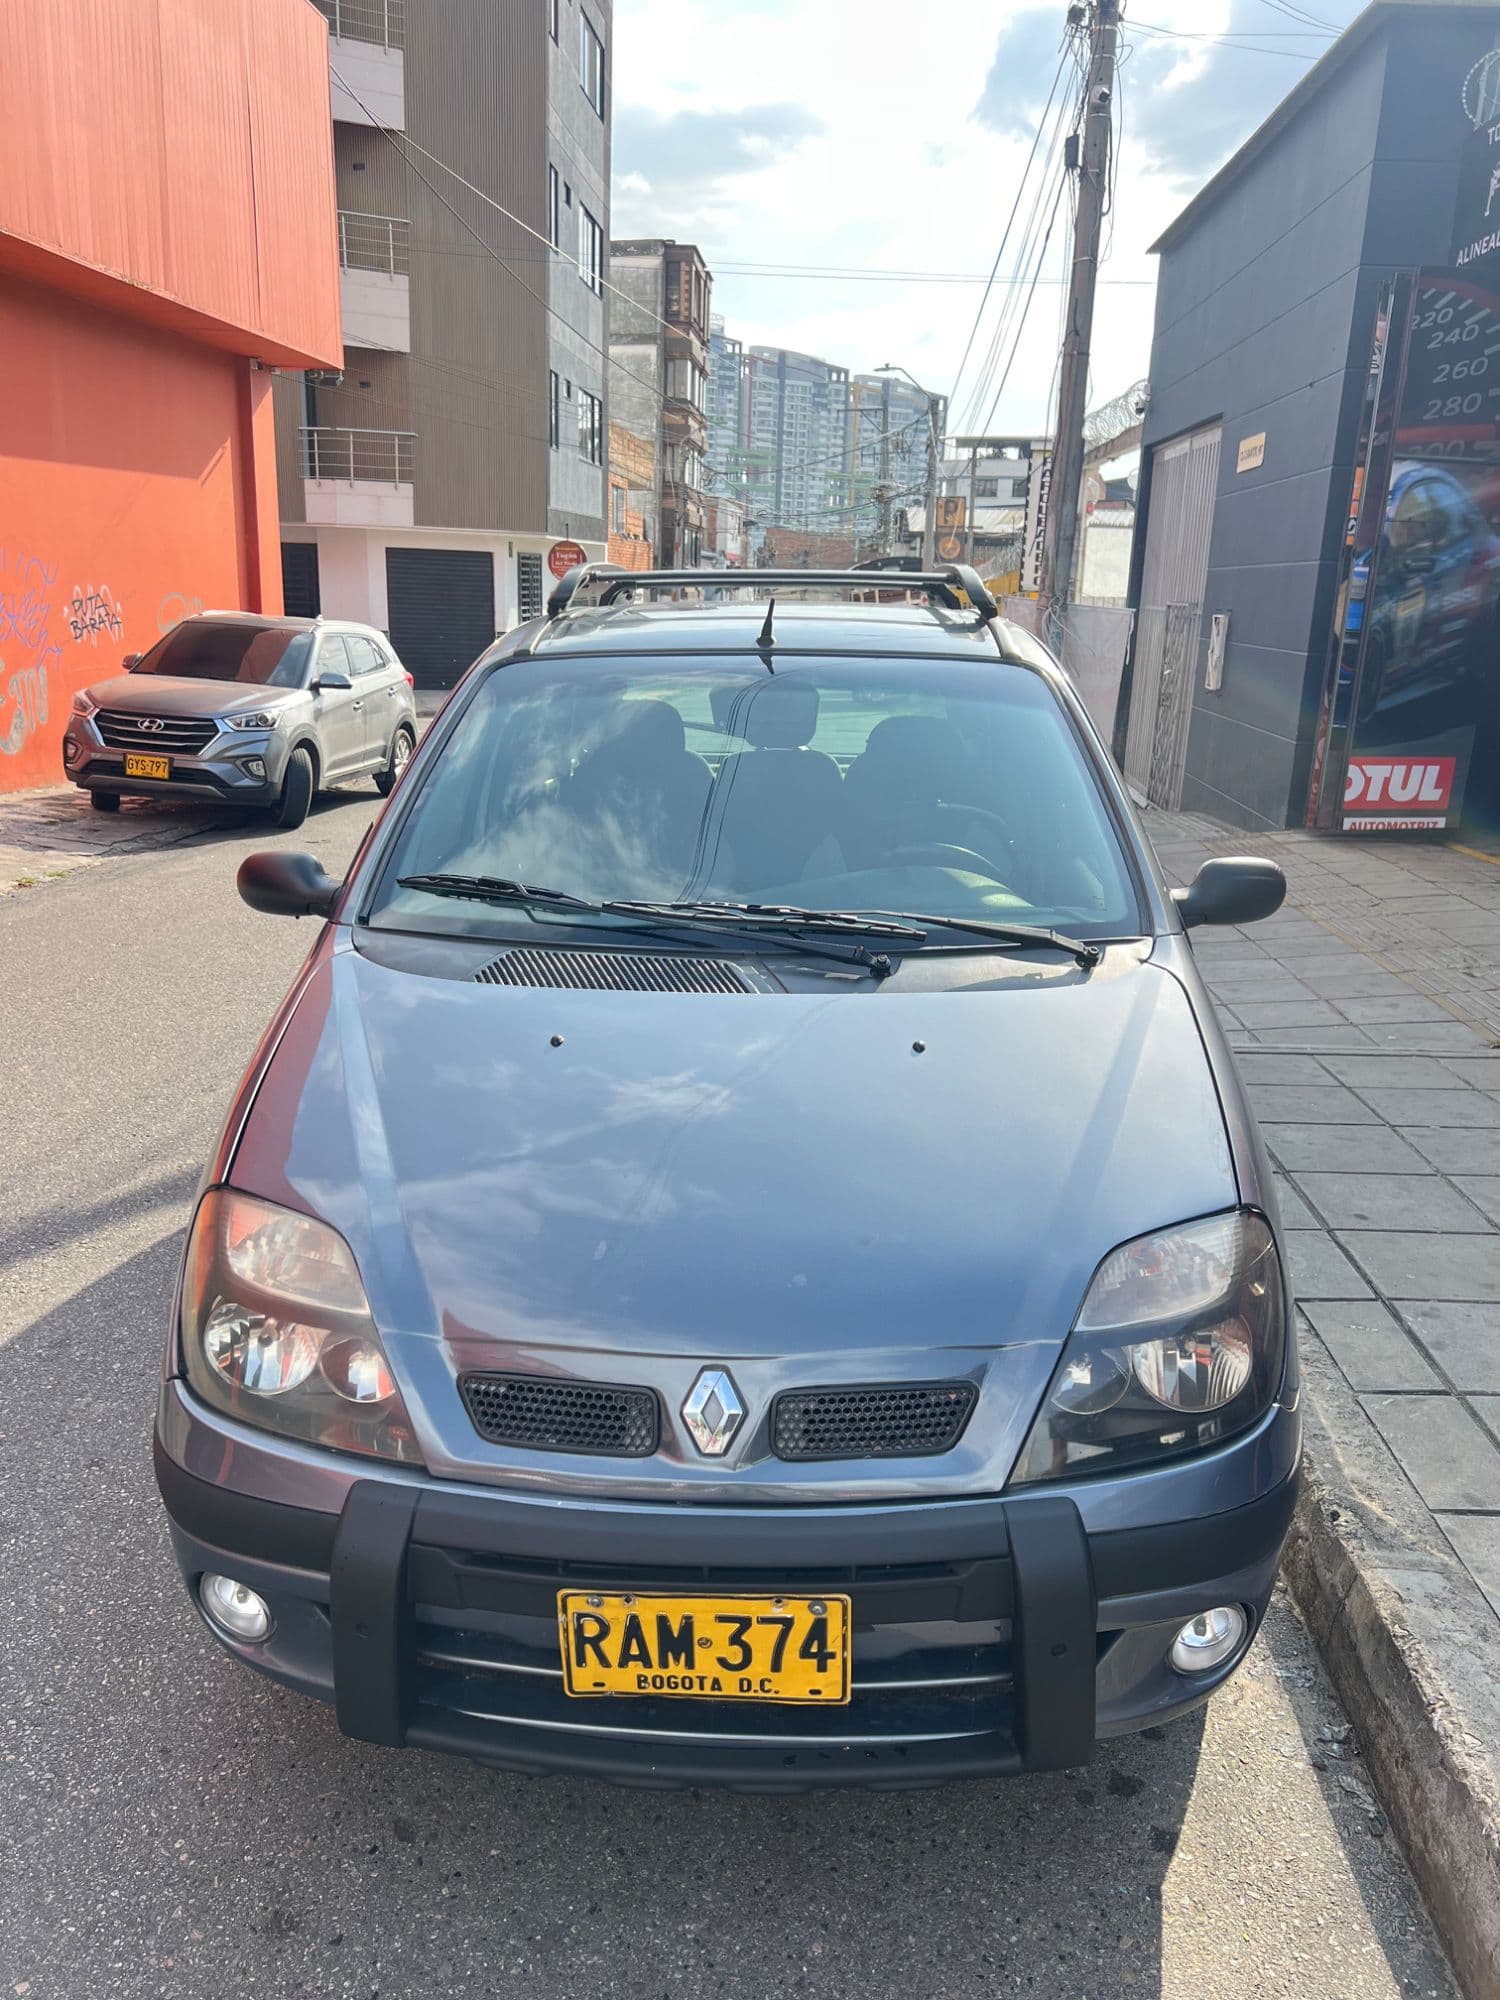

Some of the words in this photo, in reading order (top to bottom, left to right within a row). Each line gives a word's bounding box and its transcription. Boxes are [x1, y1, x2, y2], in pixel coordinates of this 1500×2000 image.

[1426, 323, 1480, 350] 240
[1431, 355, 1489, 384] 260
[1422, 391, 1482, 421] 280
[72, 593, 109, 617] PUTA
[70, 613, 122, 640] BARATA
[1349, 821, 1439, 831] AUTOMOTRIZ
[573, 1611, 695, 1670] RAM
[714, 1613, 837, 1673] 374
[636, 1674, 723, 1692] BOGOTA
[738, 1677, 781, 1694] D.C.
